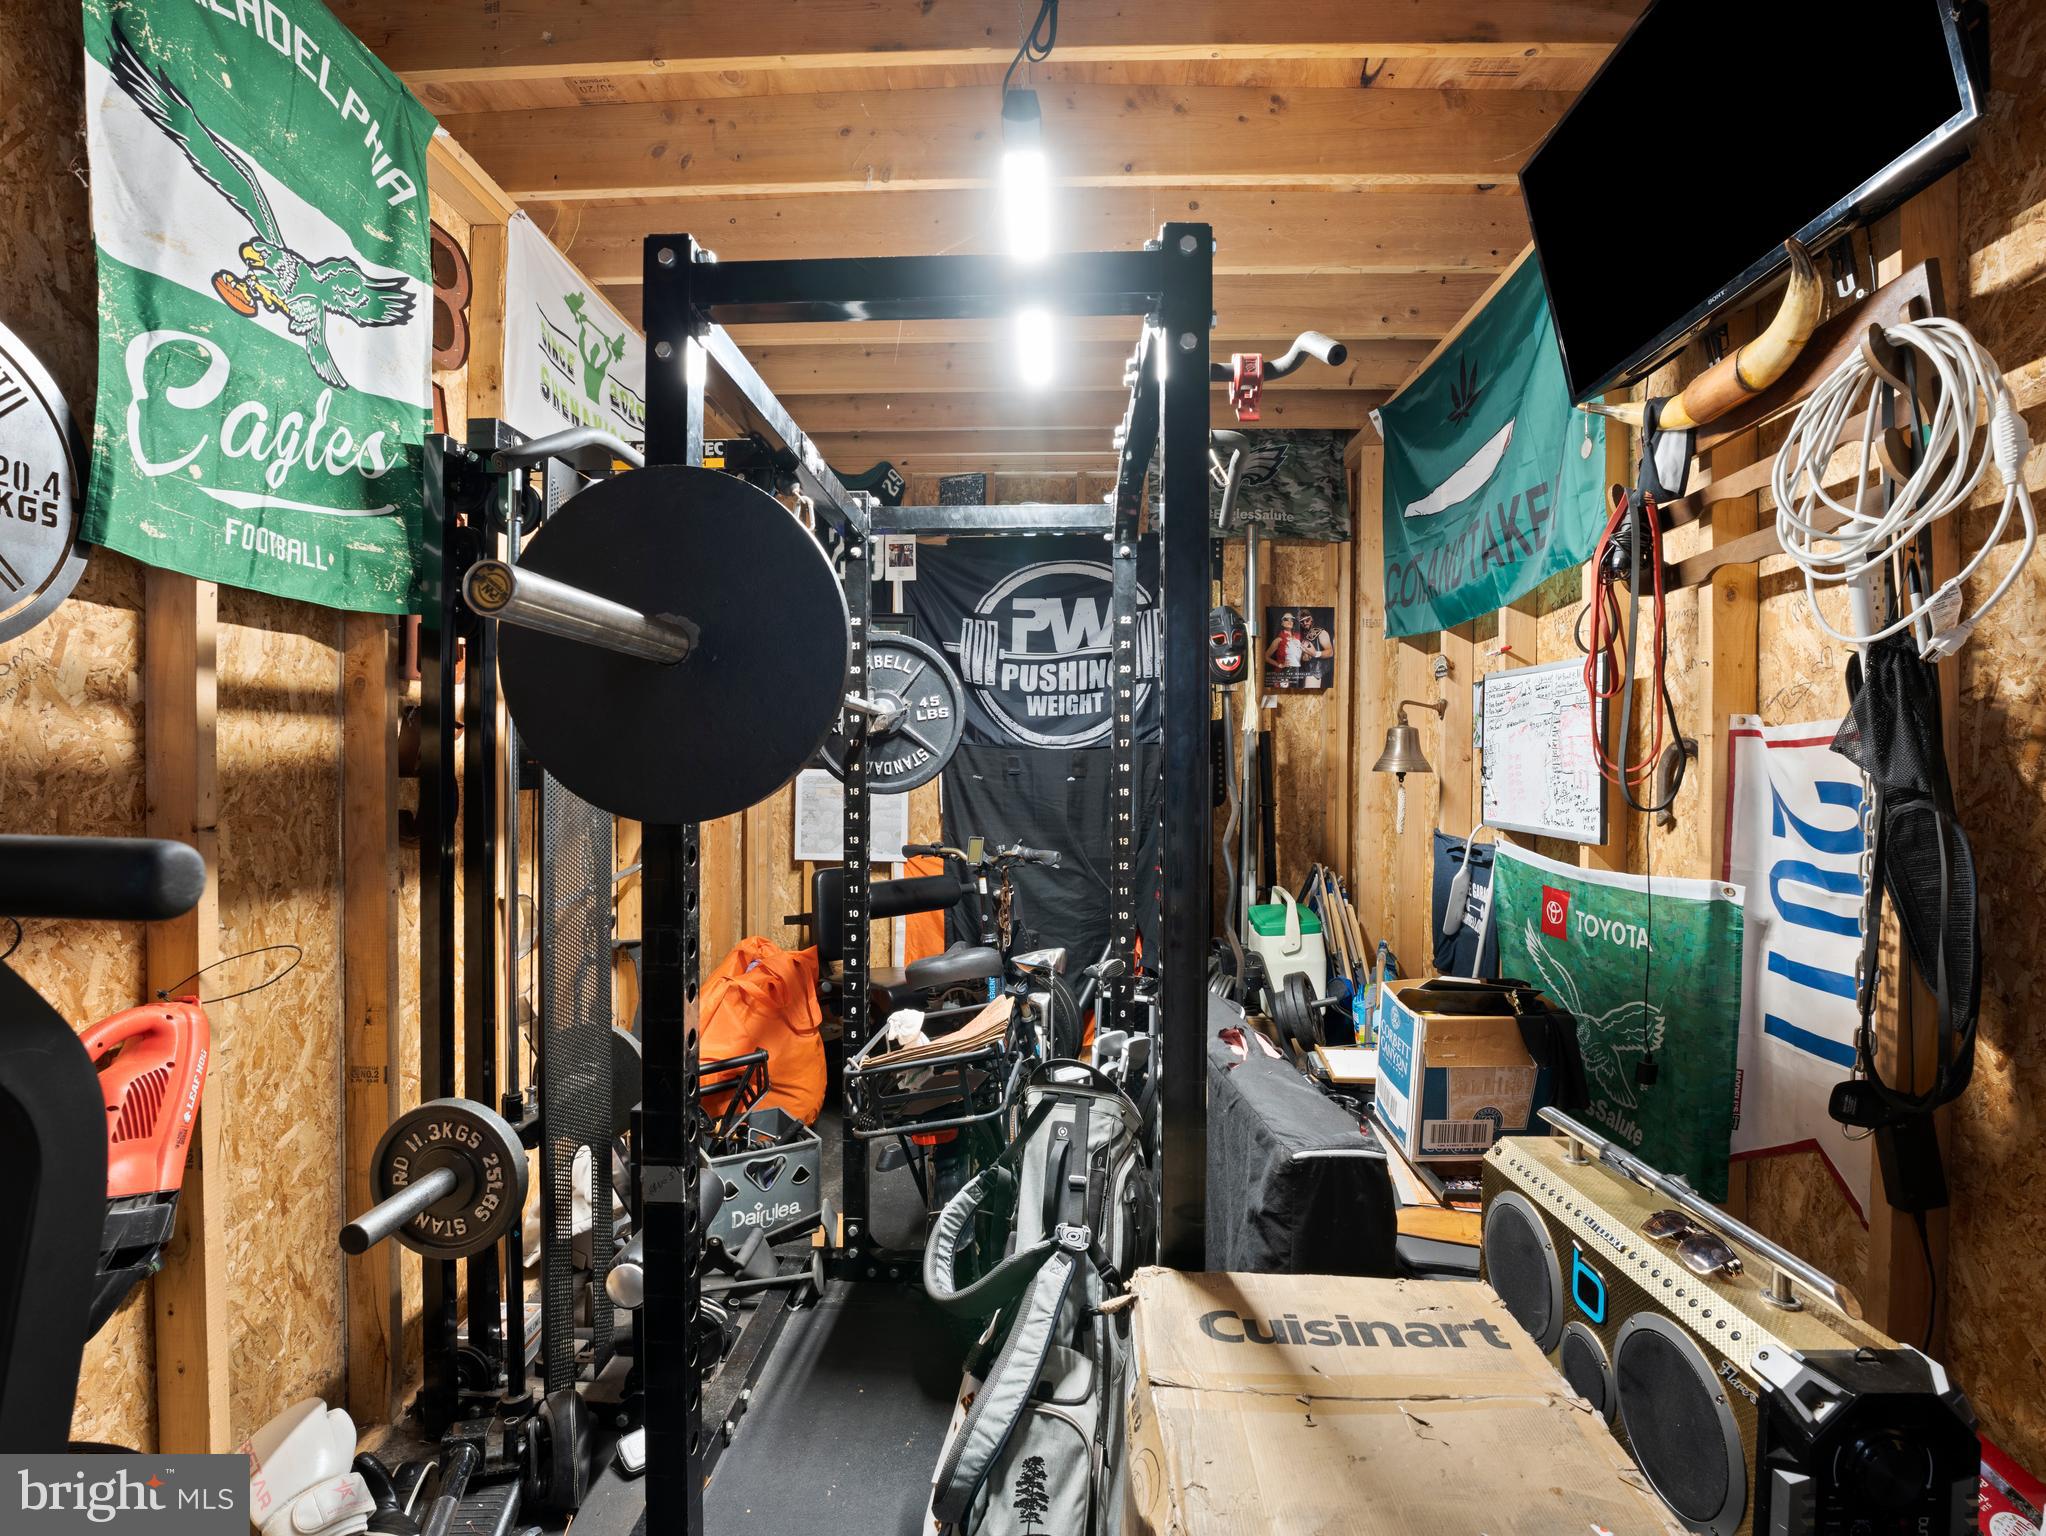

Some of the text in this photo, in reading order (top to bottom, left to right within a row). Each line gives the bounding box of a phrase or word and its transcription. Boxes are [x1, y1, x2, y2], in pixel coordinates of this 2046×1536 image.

[125, 329, 398, 489] Eagles
[1468, 481, 1551, 580] TAKE
[225, 518, 328, 571] FOOTBALL
[1012, 597, 1114, 654] PW
[1119, 615, 1133, 625] 22
[850, 641, 862, 651] 21
[1119, 640, 1132, 650] 21
[849, 665, 862, 675] 20
[1118, 664, 1132, 675] 20
[1118, 689, 1131, 699] 19
[1026, 692, 1105, 717] WEIGHT
[849, 714, 861, 724] 18
[916, 707, 949, 721] LBS
[1118, 713, 1131, 723] 18
[1118, 738, 1131, 748] 17
[1118, 763, 1130, 773] 16
[848, 786, 861, 797] 15
[1118, 787, 1130, 797] 15
[848, 811, 861, 821] 14
[1118, 812, 1130, 822] 14
[848, 835, 861, 846] 13
[1118, 836, 1130, 847] 13
[848, 860, 861, 870] 12
[1118, 861, 1130, 871] 12
[848, 884, 860, 894] 11
[1118, 886, 1129, 896] 11
[848, 909, 861, 919] 10
[1117, 910, 1130, 921] 10
[1575, 909, 1653, 952] TOYOTA
[1381, 1018, 1411, 1055] CORBETT
[1380, 1038, 1409, 1076] CANYON
[186, 1048, 208, 1111] LEAF HOG
[392, 1156, 410, 1187] RD
[731, 1201, 802, 1229] Dairylea
[414, 1211, 468, 1238] STAN
[1199, 1309, 1512, 1350] Cuisinart
